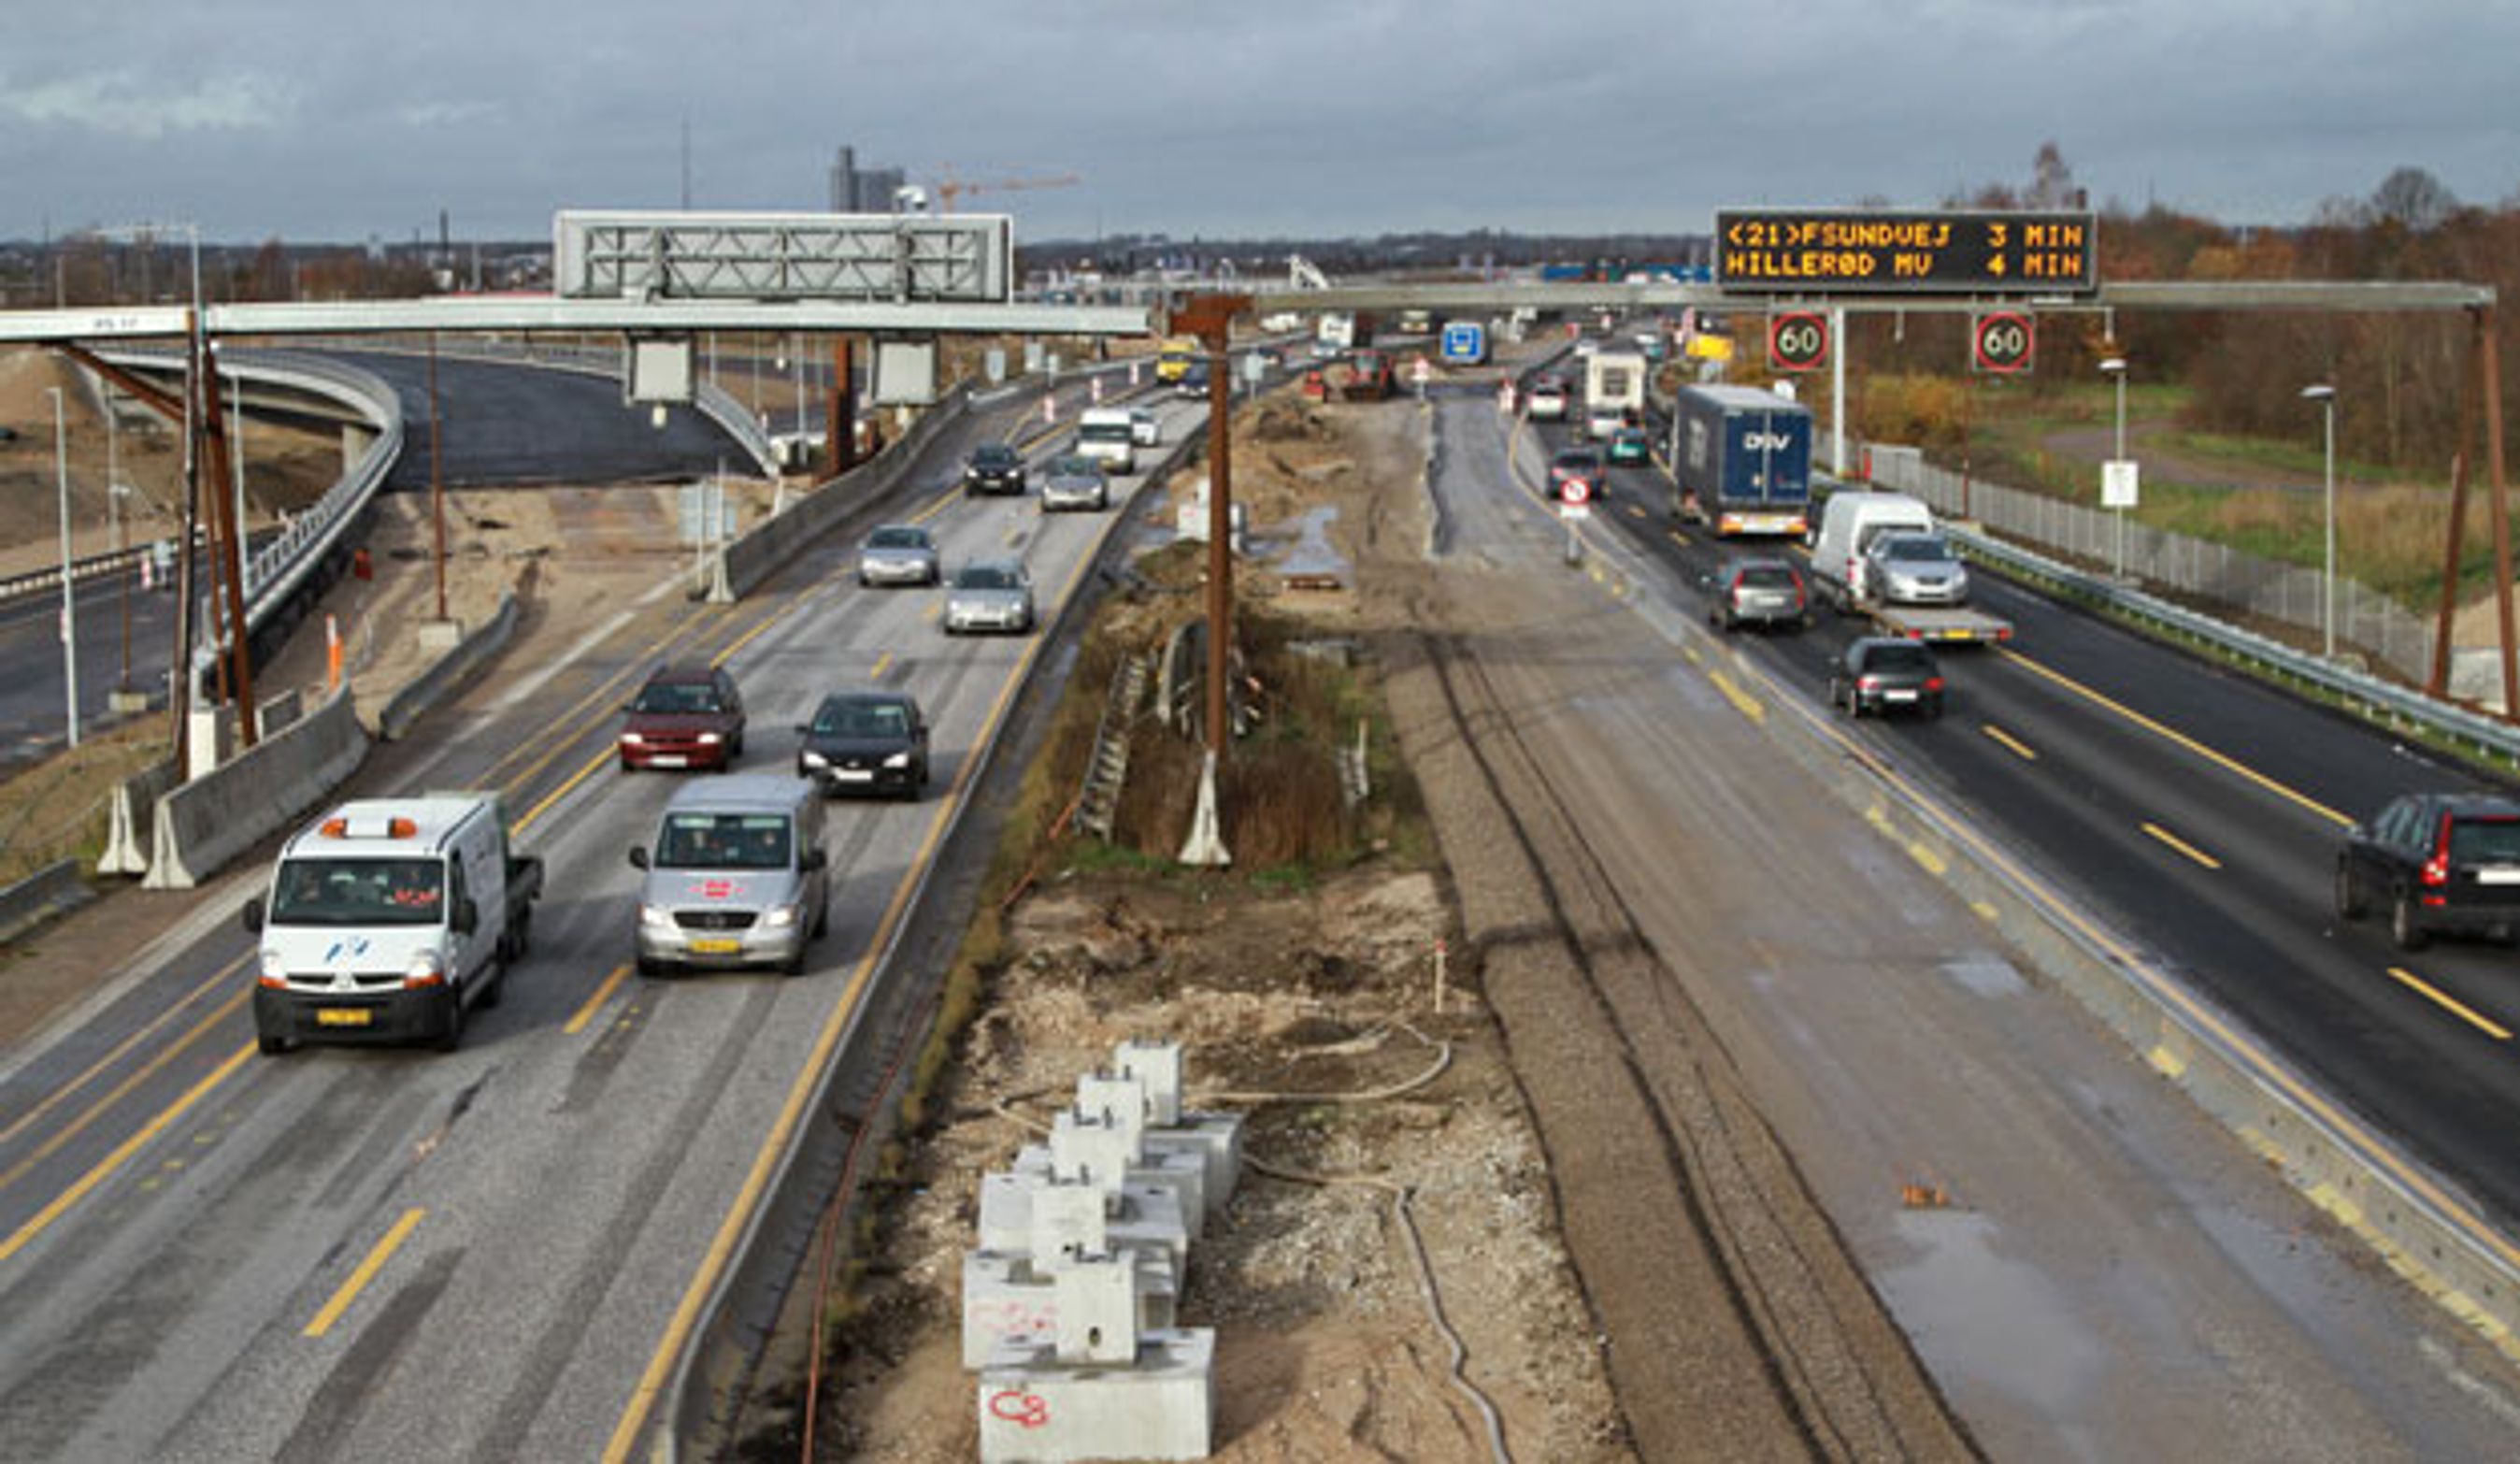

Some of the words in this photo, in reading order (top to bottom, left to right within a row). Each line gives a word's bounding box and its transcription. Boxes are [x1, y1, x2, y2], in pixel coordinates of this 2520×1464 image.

[1987, 222, 2007, 247] 3
[2025, 223, 2083, 247] MIN
[1726, 251, 1876, 276] HILLERØD
[1895, 251, 1933, 277] MV
[1985, 252, 2006, 276] 4
[2024, 253, 2082, 277] MIN
[1778, 324, 1820, 354] 60
[1983, 324, 2024, 354] 60
